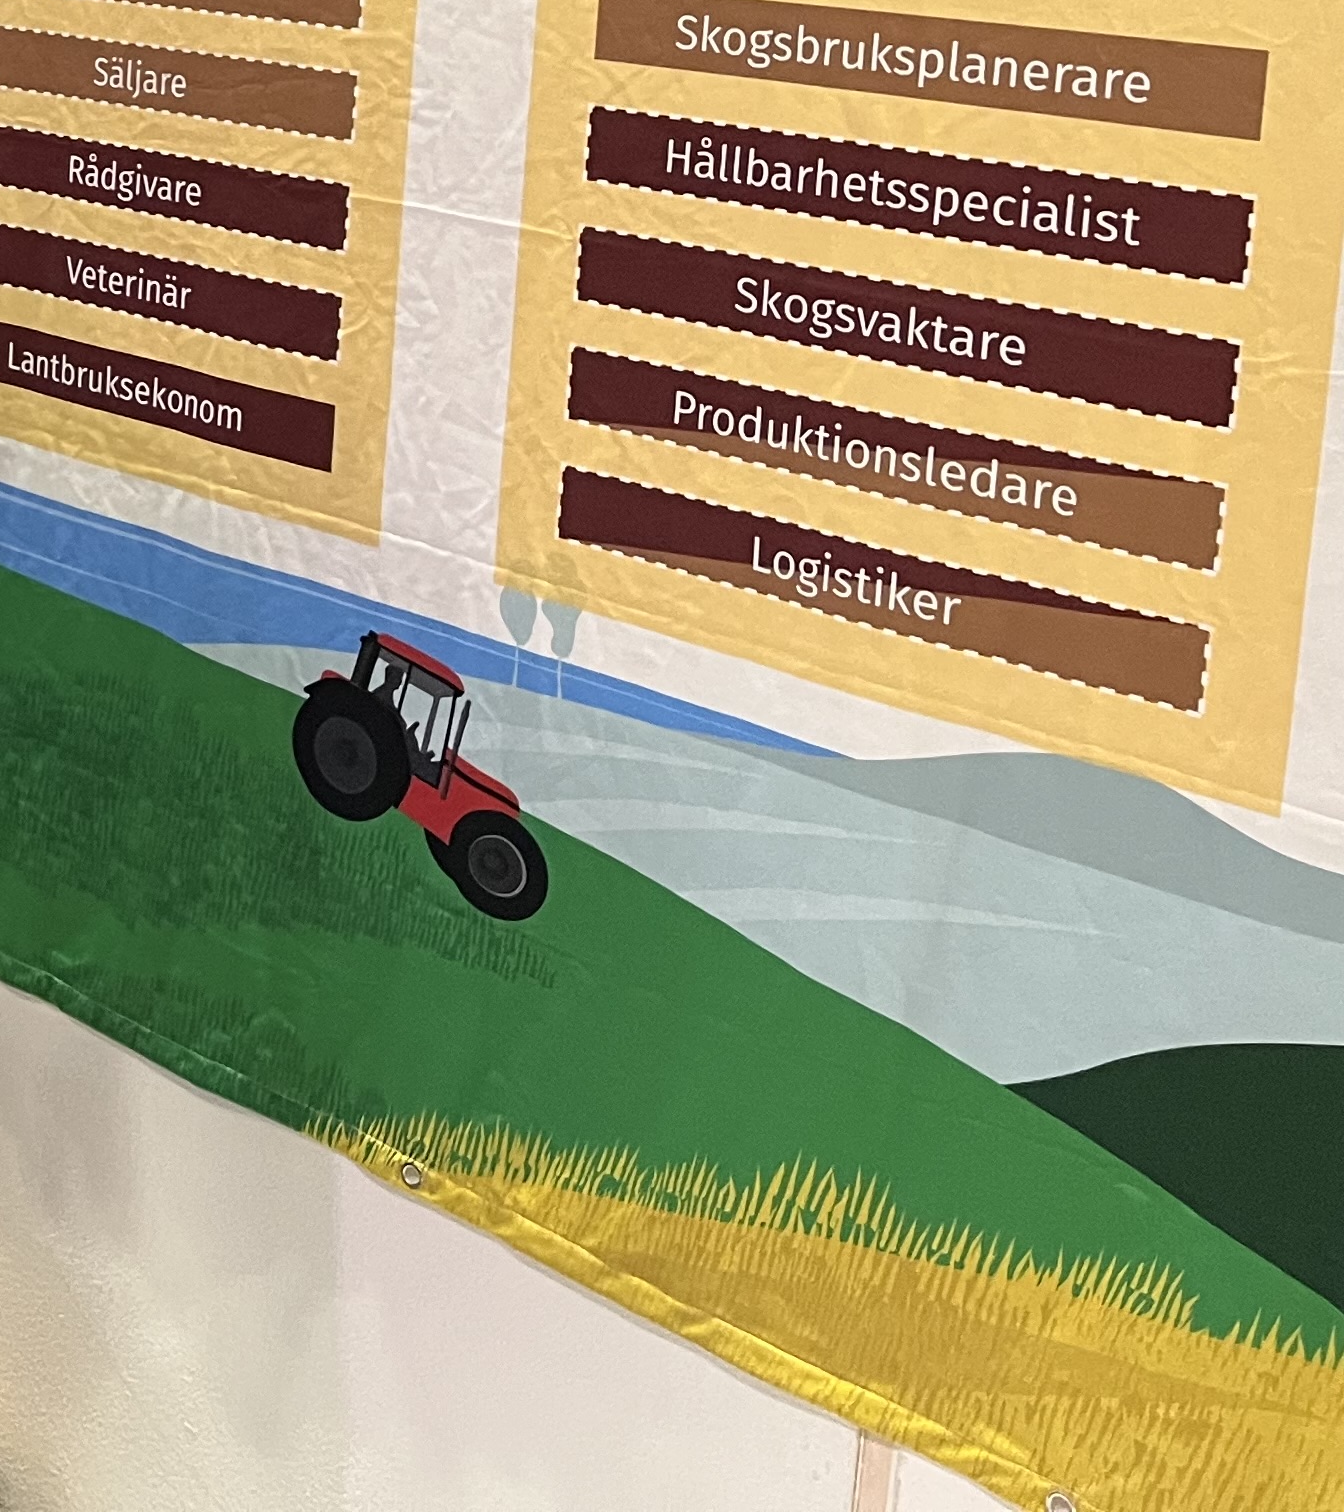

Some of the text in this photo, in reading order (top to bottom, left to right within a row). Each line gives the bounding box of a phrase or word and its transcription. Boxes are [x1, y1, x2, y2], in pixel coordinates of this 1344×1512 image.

[94, 57, 186, 98] Säljare
[676, 15, 1150, 103] Skogsbruksplanerare
[69, 154, 201, 206] Rådgivare
[667, 137, 1140, 246] Hållbarhetsspecialist
[67, 256, 191, 309] Veterinär
[735, 278, 1025, 365] Skogsvaktare
[8, 342, 242, 431] Lantbruksekonom
[674, 391, 1077, 516] Produktionsledare
[753, 536, 961, 625] Logistiker
